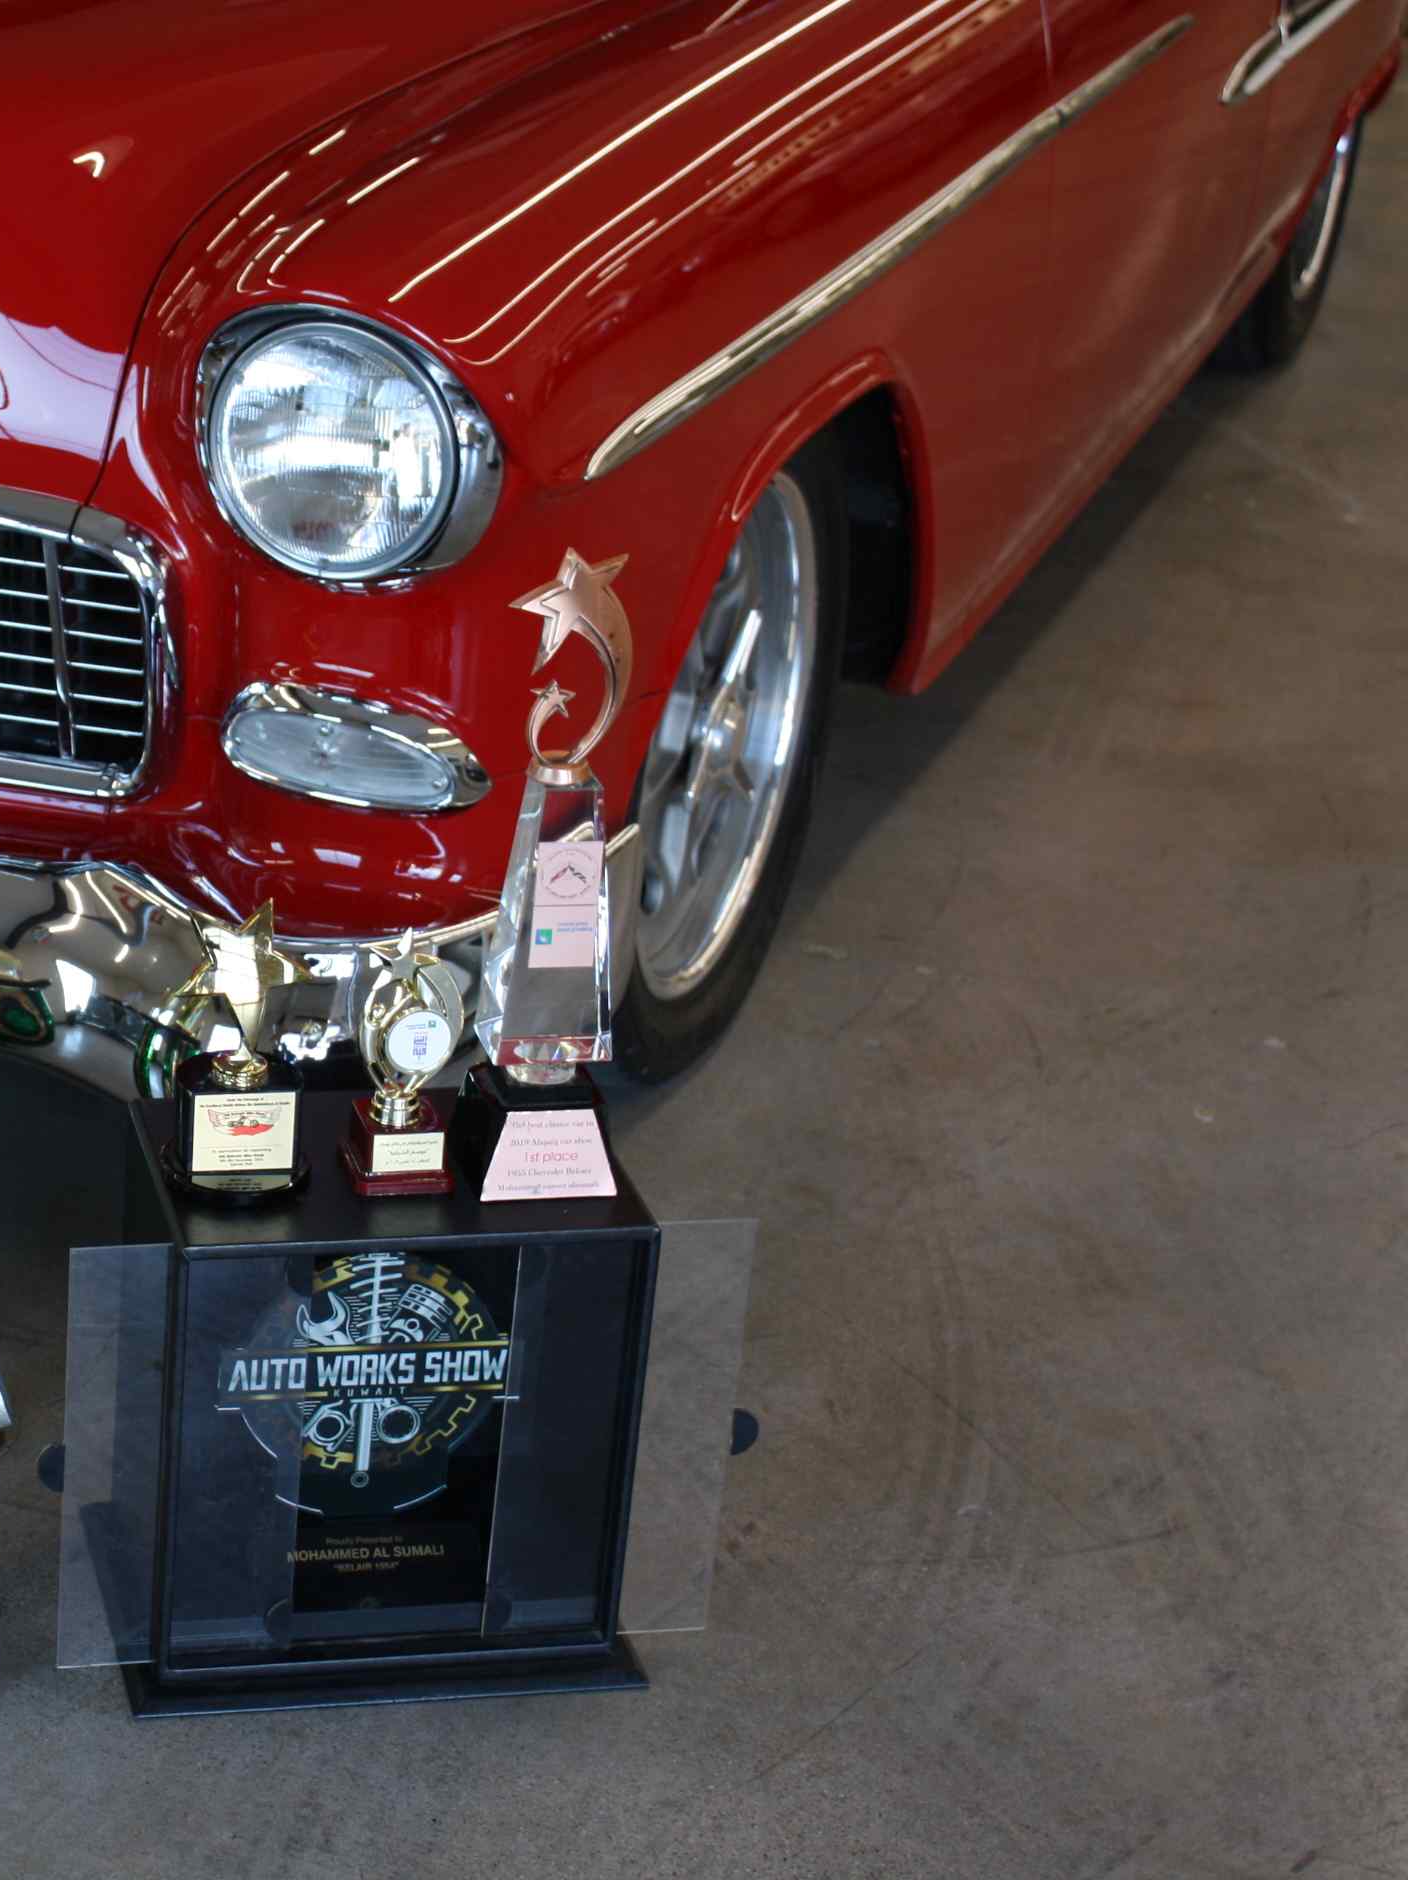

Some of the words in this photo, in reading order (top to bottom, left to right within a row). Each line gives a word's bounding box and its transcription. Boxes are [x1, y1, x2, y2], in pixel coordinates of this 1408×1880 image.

[542, 1152, 579, 1164] place
[227, 1357, 308, 1393] AUTO
[316, 1352, 417, 1388] WORKS
[423, 1348, 508, 1384] SHOW
[333, 1386, 407, 1397] KUWAIT
[286, 1547, 369, 1563] MOHAMMED
[372, 1547, 391, 1559] AL
[393, 1544, 445, 1557] SUMALI
